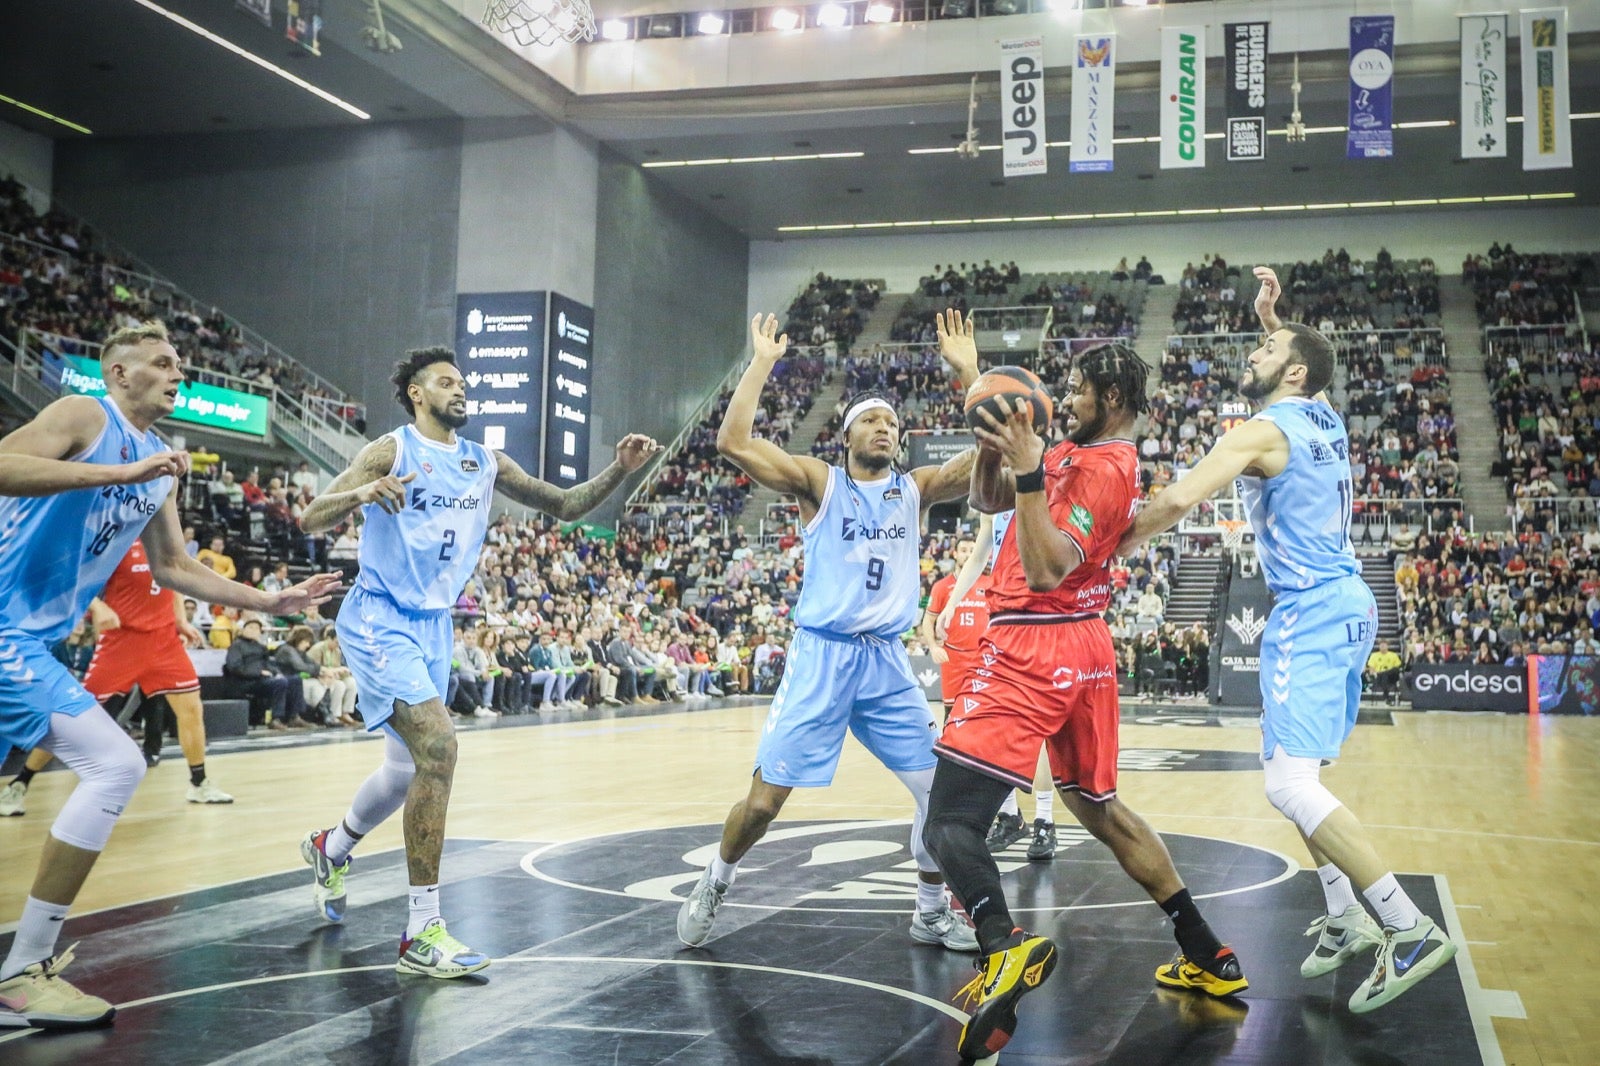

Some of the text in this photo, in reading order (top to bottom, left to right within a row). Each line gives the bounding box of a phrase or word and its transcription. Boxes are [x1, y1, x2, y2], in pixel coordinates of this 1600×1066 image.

[1235, 25, 1249, 91] DE VERDAD
[1248, 24, 1265, 108] BURGERS
[1004, 56, 1042, 156] Jeep
[1086, 72, 1100, 155] MANZANO
[1170, 33, 1196, 160] COVIRAN
[87, 520, 120, 556] 18
[438, 528, 456, 561] 2
[866, 557, 885, 591] 9
[959, 612, 975, 626] 15
[1415, 670, 1523, 694] endesa
